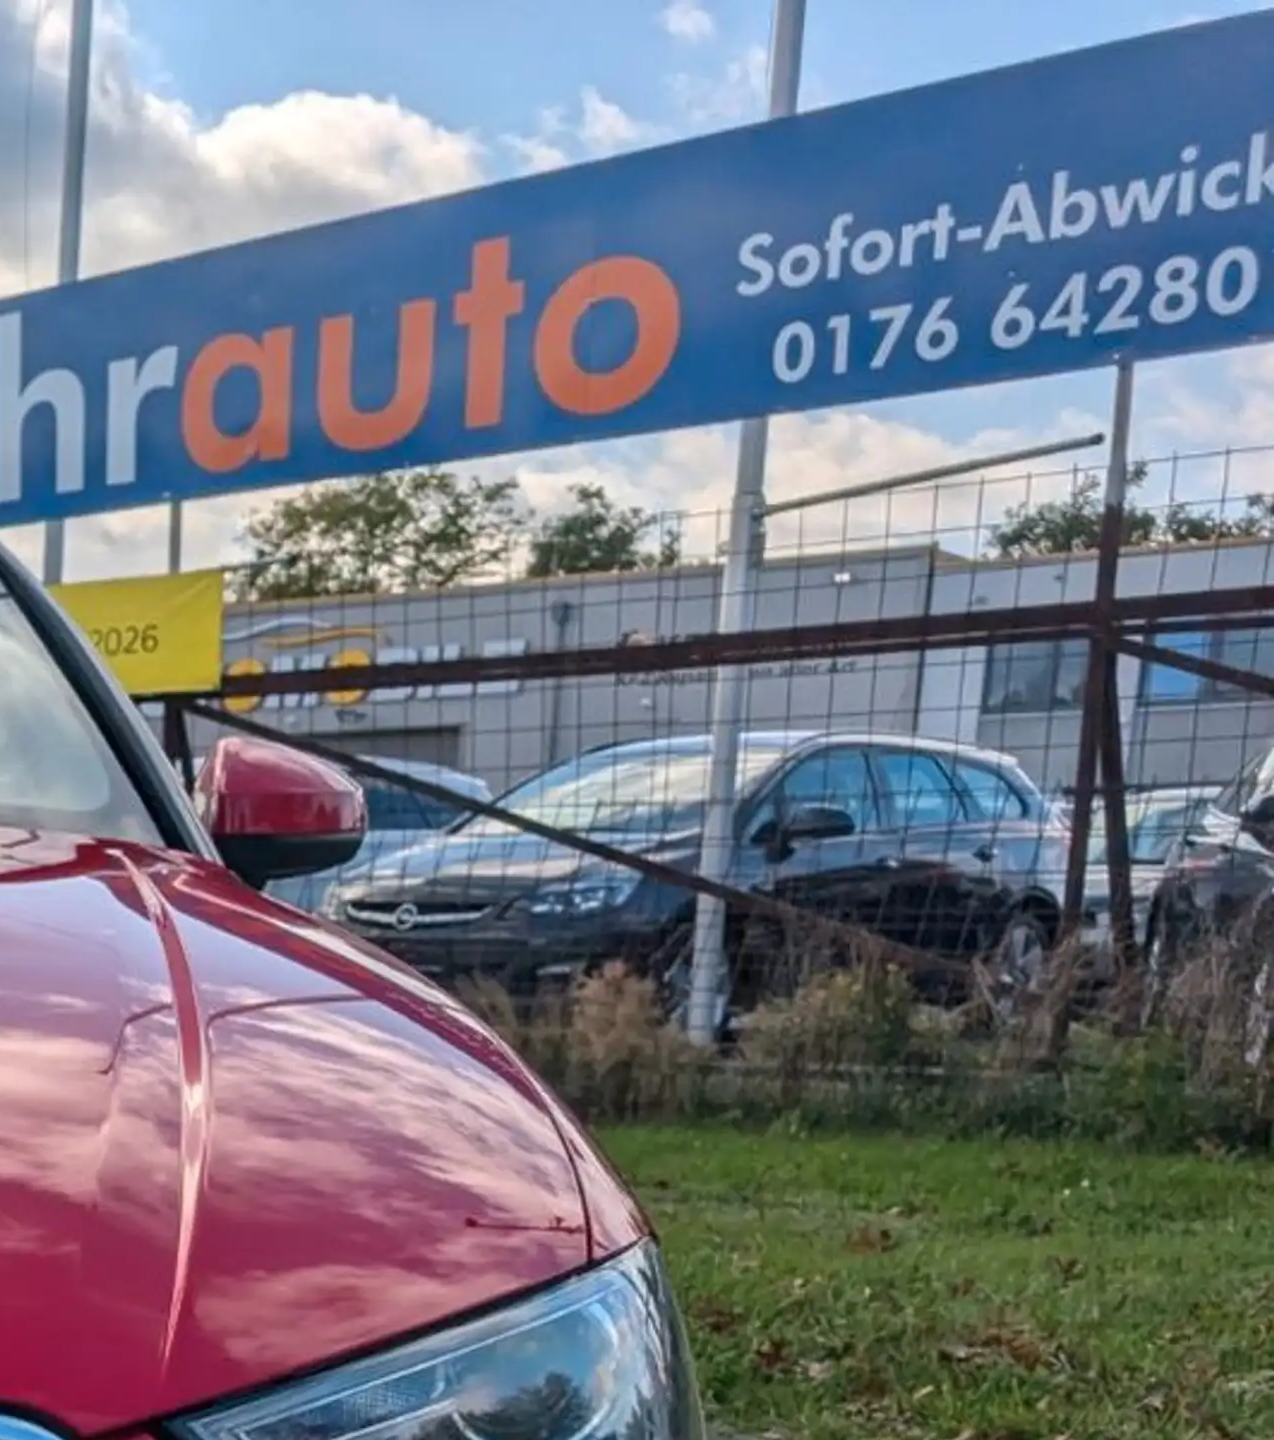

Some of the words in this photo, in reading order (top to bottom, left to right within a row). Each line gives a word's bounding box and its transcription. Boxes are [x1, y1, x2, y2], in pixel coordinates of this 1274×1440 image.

[736, 131, 1274, 297] Sofort-Abwick
[772, 296, 959, 383] 0176
[989, 245, 1260, 350] 64280
[89, 623, 159, 657] 2026
